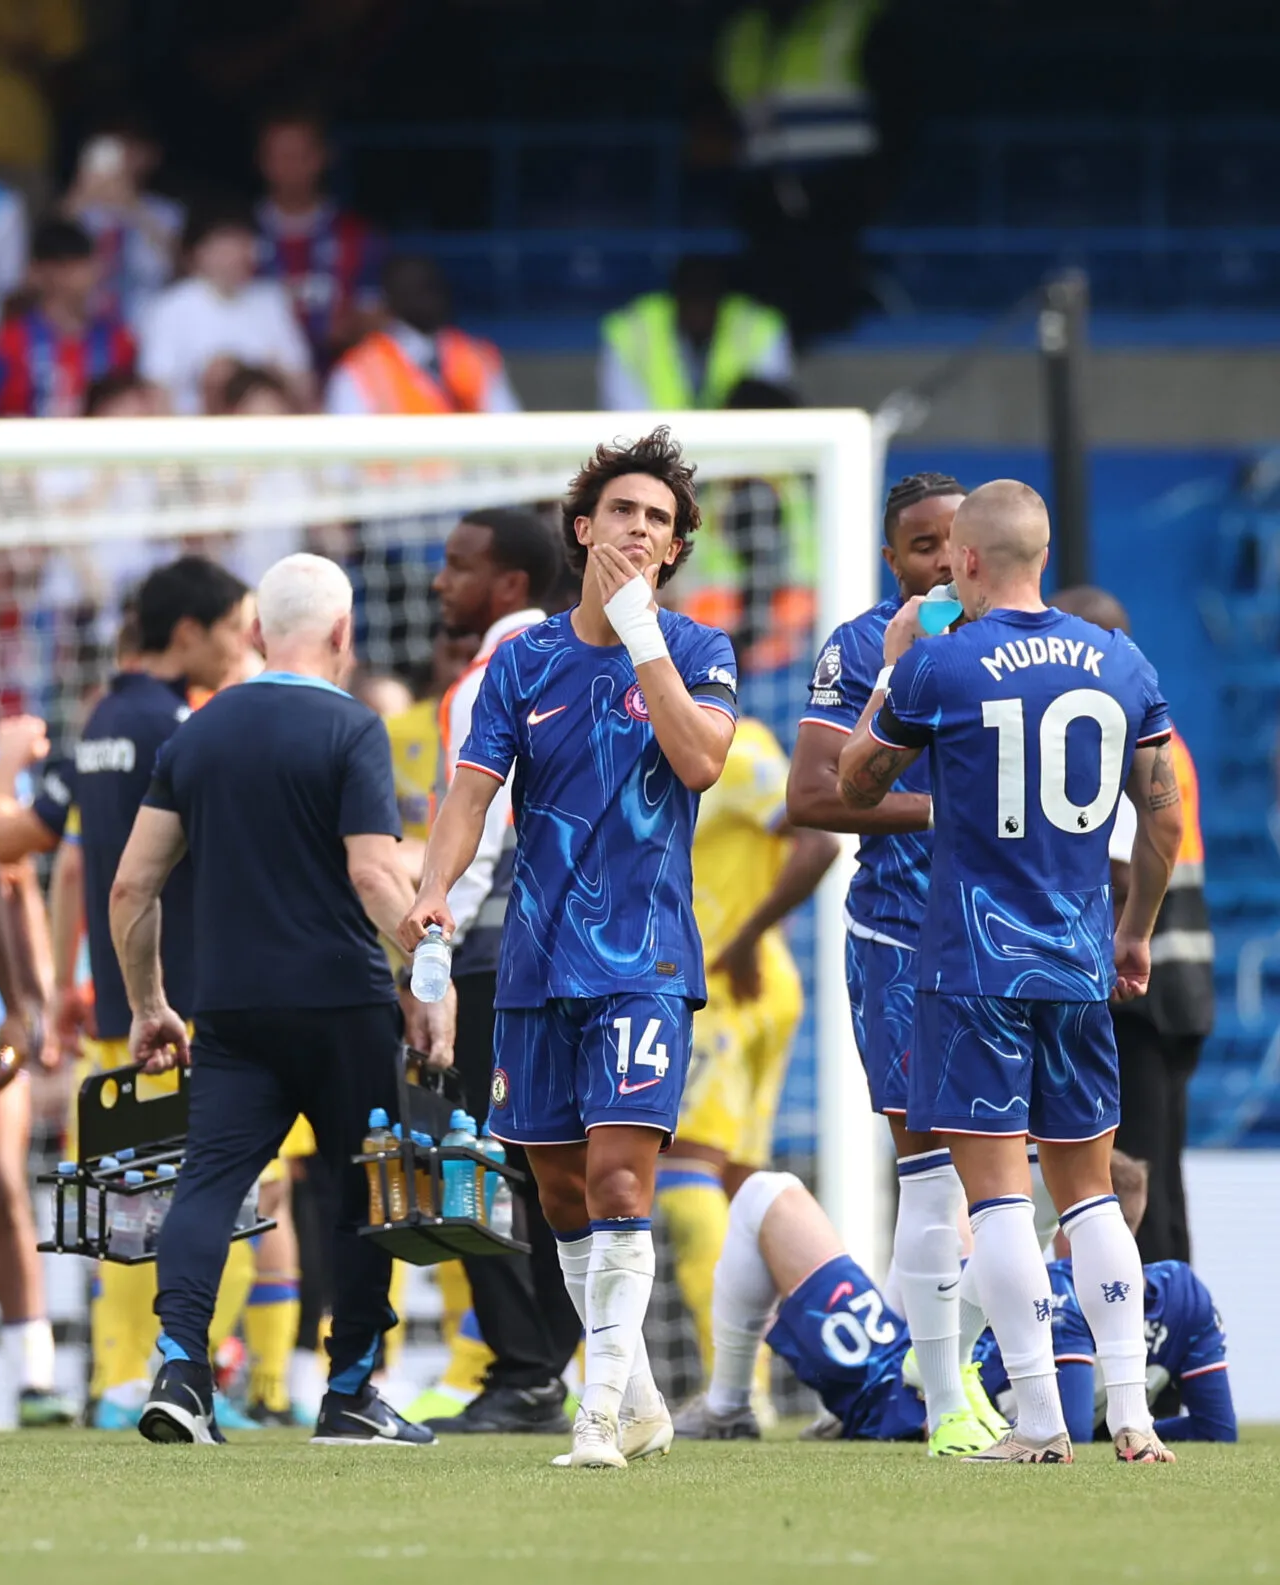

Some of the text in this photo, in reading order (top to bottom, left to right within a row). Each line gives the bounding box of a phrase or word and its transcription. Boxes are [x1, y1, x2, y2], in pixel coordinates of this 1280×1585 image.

[980, 637, 1104, 681] MUDRYK
[981, 688, 1127, 839] 10
[613, 1016, 670, 1078] 14
[821, 1288, 896, 1367] 20
